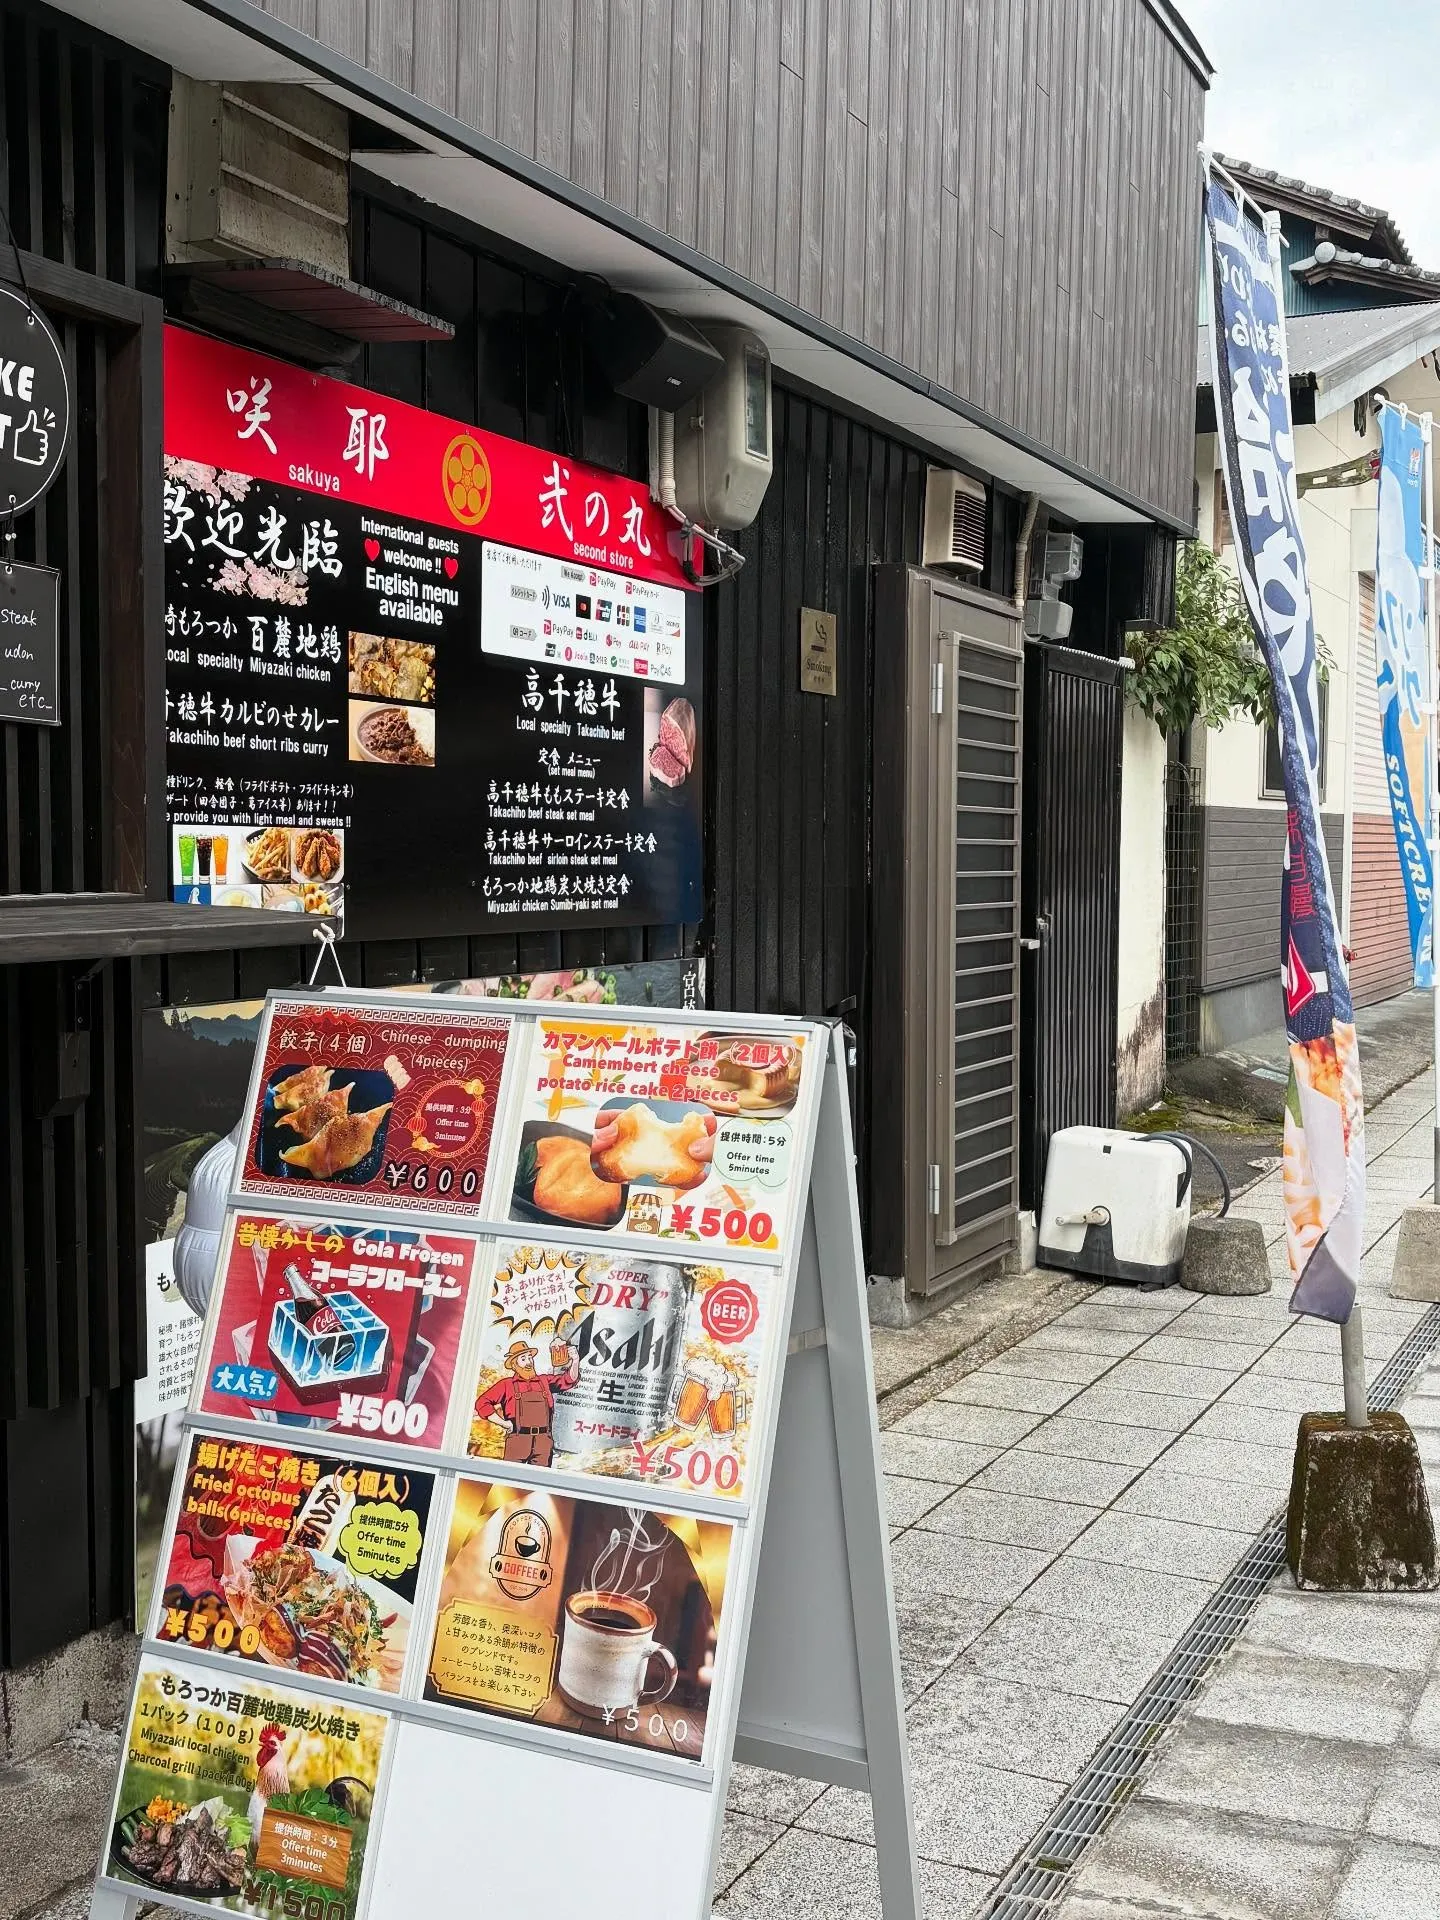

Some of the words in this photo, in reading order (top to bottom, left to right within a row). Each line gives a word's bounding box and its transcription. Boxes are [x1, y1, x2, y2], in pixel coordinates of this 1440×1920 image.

[288, 464, 340, 492] sakuya
[361, 517, 424, 545] International
[428, 534, 459, 555] guests
[383, 549, 433, 571] welcome
[573, 542, 607, 563] second
[609, 551, 634, 569] store
[366, 567, 419, 598] English
[421, 584, 459, 606] menu
[379, 598, 443, 626] available
[553, 593, 570, 608] VISA
[553, 624, 574, 637] PayPay
[5, 644, 33, 660] udon
[165, 648, 190, 663] ocal
[197, 652, 244, 673] specialty
[250, 657, 293, 677] Miyazaki
[296, 666, 331, 682] chicken
[806, 658, 832, 677] Smoking
[521, 667, 621, 722] 高千穂牛
[516, 715, 536, 731] Local
[540, 718, 571, 737] specialty
[577, 722, 610, 740] Takachiho
[611, 727, 626, 741] beef
[223, 731, 246, 749] beef
[250, 735, 277, 751] short
[280, 737, 300, 753] ribs
[303, 741, 329, 756] curry
[538, 748, 561, 766] 定食
[567, 752, 601, 765] メニュー
[562, 766, 576, 777] meal
[173, 811, 209, 823] provide
[212, 813, 229, 824] you
[232, 812, 251, 824] with
[254, 813, 273, 826] light
[276, 814, 296, 825] meal
[298, 815, 313, 825] and
[315, 816, 344, 827] sweets
[489, 805, 526, 819] Takachiho
[527, 806, 543, 819] beef
[545, 807, 564, 820] steak
[566, 809, 578, 821] set
[579, 810, 595, 822] meal
[489, 853, 526, 865] Takachiho
[527, 853, 543, 865] beef
[570, 853, 588, 865] steak
[590, 853, 601, 865] set
[602, 853, 618, 865] meal
[487, 899, 520, 914] Miyazaki
[522, 899, 549, 912] chicken
[591, 898, 602, 909] set
[603, 897, 619, 909] meal
[381, 1029, 432, 1045] Chinese
[444, 1034, 507, 1053] dumpling
[411, 1053, 469, 1072] (4pieces)
[562, 1053, 658, 1074] Camembert
[660, 1061, 721, 1079] cheese
[537, 1075, 592, 1093] potato
[595, 1077, 627, 1094] rice
[629, 1080, 668, 1097] cake
[671, 1082, 738, 1103] 2pieces
[435, 1118, 453, 1127] Offer
[454, 1120, 469, 1128] time
[435, 1131, 466, 1142] 3minutes
[726, 1151, 751, 1163] Offer
[754, 1153, 775, 1164] time
[728, 1162, 770, 1176] 5minutes
[671, 1203, 774, 1243] ¥500
[352, 1238, 394, 1259] Cola
[399, 1244, 464, 1267] Frozen
[311, 1259, 462, 1298] コーラフローズン
[608, 1270, 649, 1284] SUPER
[312, 1310, 336, 1334] Cola
[712, 1303, 747, 1321] BEER
[597, 1379, 625, 1404] 生
[337, 1393, 429, 1438] ¥500
[631, 1441, 739, 1490] ¥500
[193, 1473, 233, 1494] Fried
[236, 1483, 301, 1507] octopus
[357, 1530, 385, 1546] Offer
[386, 1536, 406, 1549] time
[357, 1546, 401, 1565] 5minutes
[503, 1562, 539, 1580] COFFEE
[140, 1727, 186, 1749] Miyazaki
[187, 1737, 211, 1756] local
[213, 1745, 250, 1766] chicken
[128, 1749, 171, 1770] Charcoal
[171, 1761, 195, 1775] grill
[281, 1837, 306, 1855] Offer
[307, 1842, 328, 1860] time
[281, 1852, 323, 1873] 3minutes
